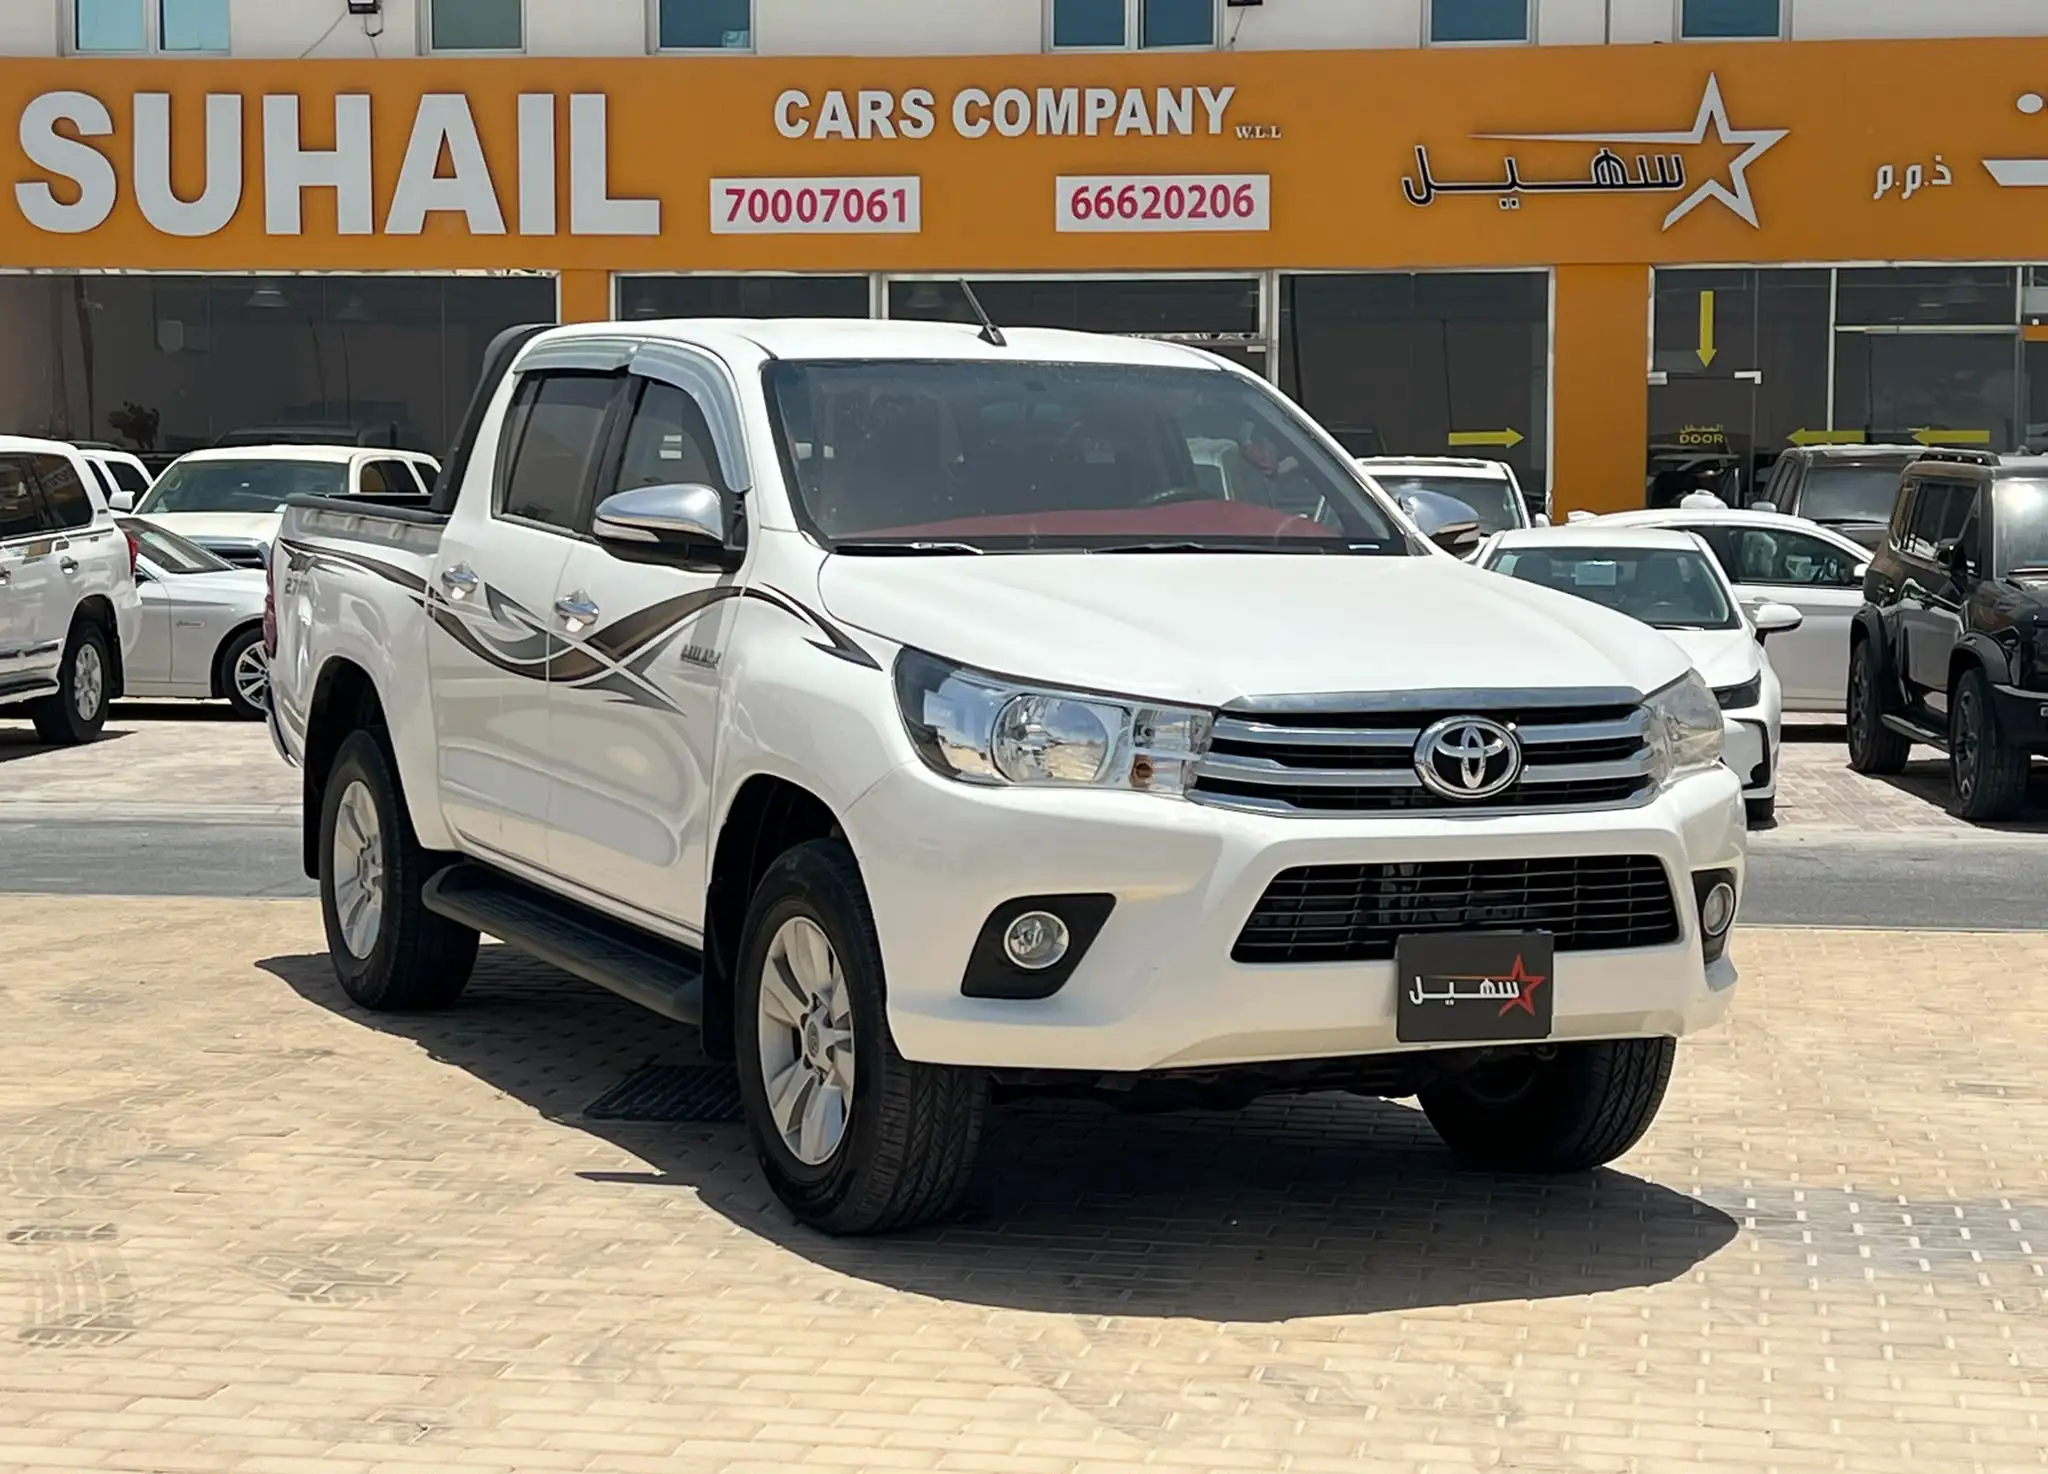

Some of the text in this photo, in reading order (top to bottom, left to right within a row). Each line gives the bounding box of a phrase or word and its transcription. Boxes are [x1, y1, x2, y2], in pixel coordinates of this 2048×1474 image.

[774, 88, 935, 139] CARS
[952, 87, 1236, 138] COMPANY
[14, 91, 662, 237] SUHAIL
[1402, 145, 1687, 210] سهيل
[725, 188, 905, 223] 70007061
[1071, 184, 1255, 219] 66620206
[1680, 434, 1724, 444] DOOR
[1409, 976, 1520, 1006] سهيل
